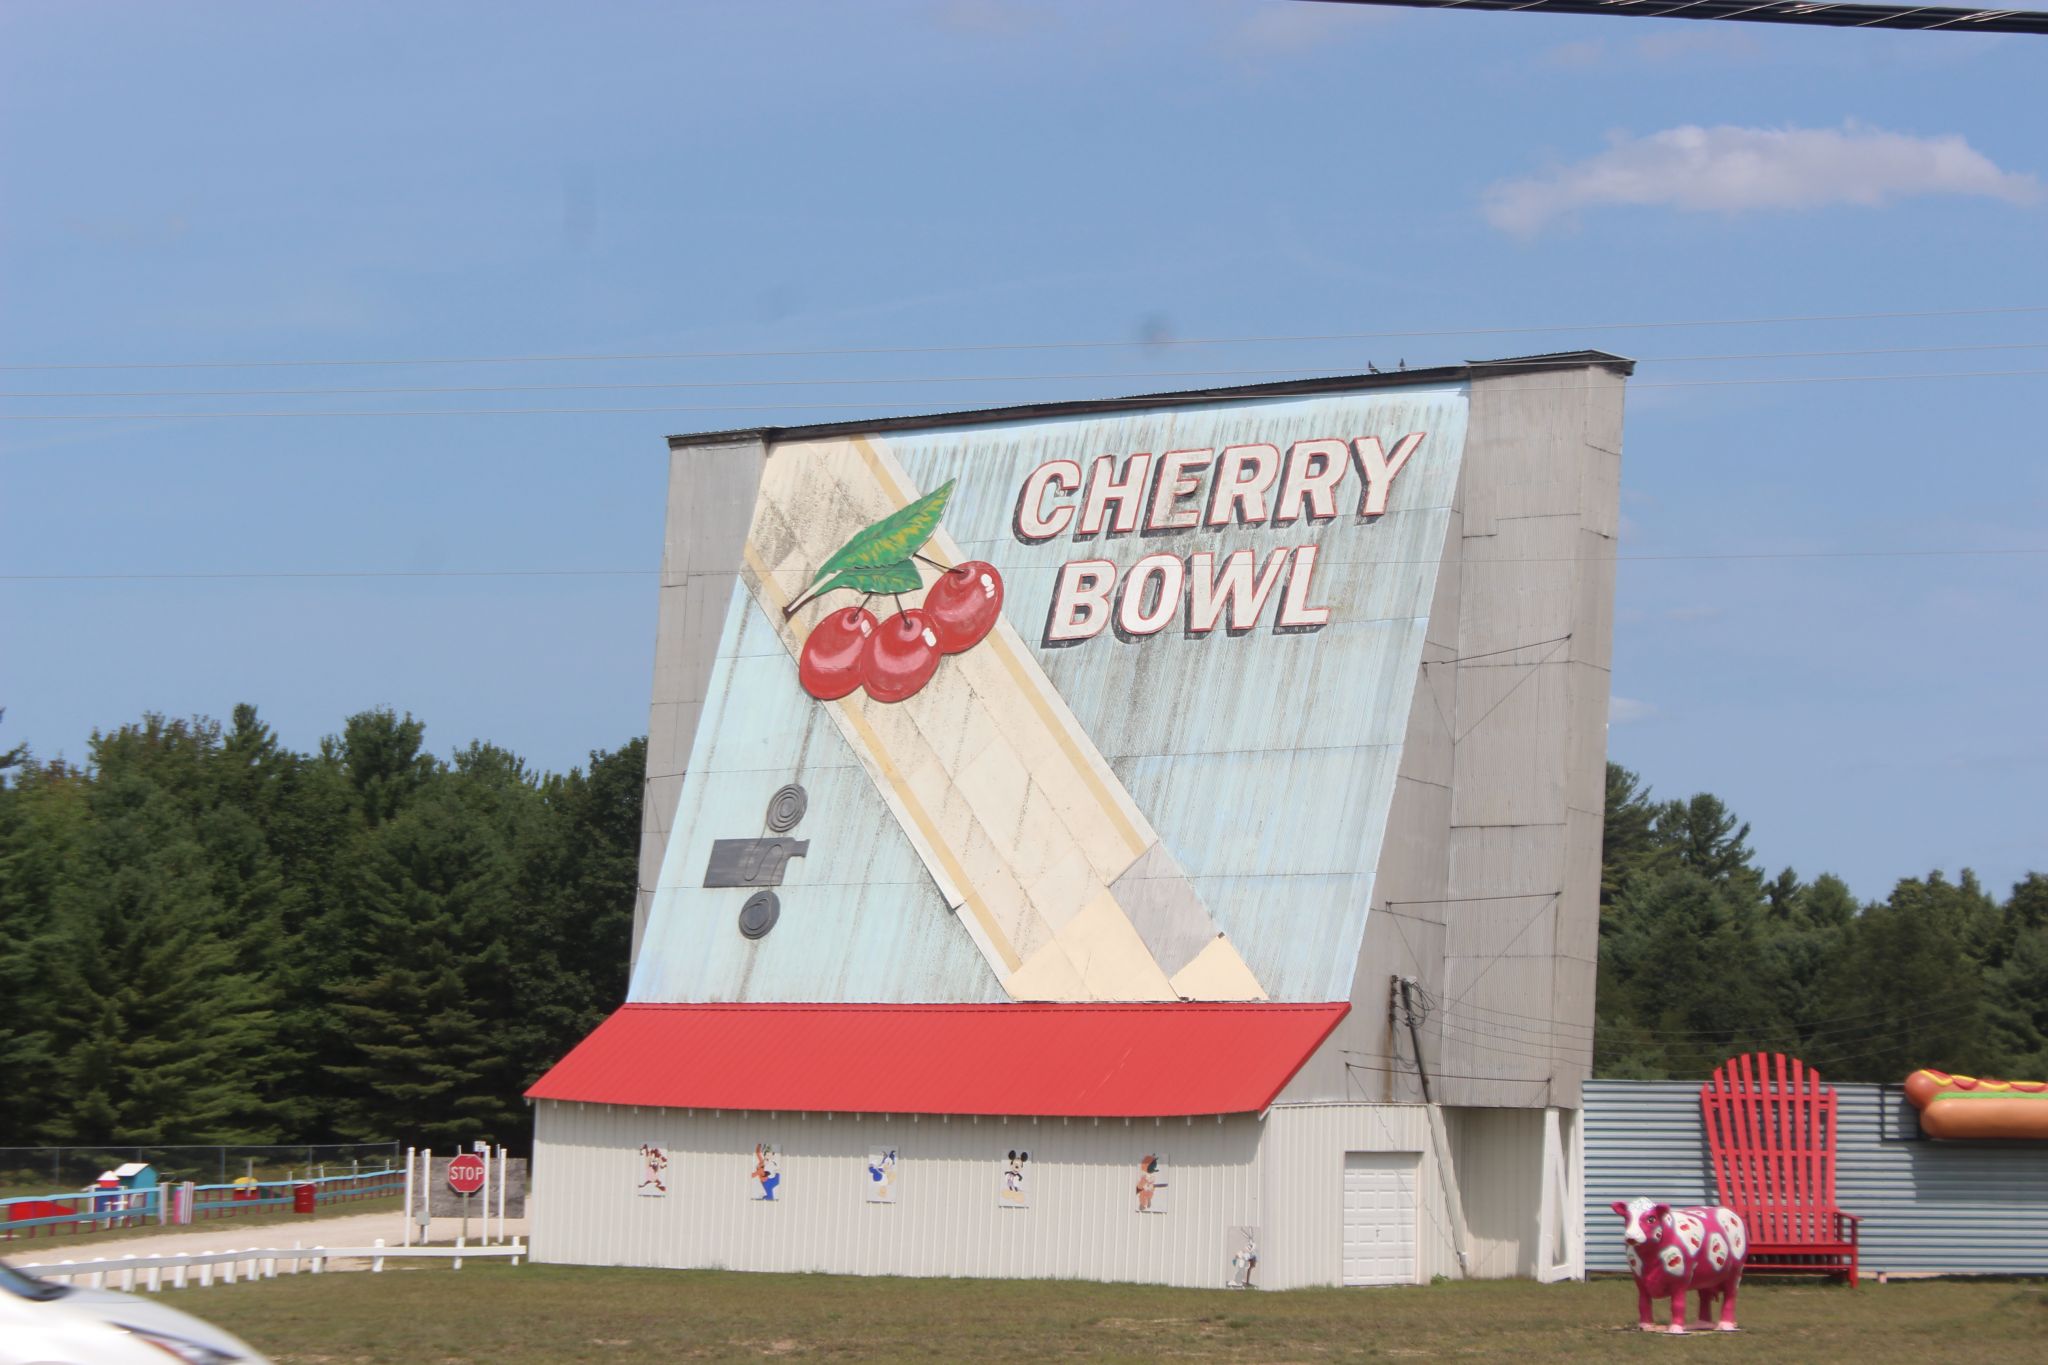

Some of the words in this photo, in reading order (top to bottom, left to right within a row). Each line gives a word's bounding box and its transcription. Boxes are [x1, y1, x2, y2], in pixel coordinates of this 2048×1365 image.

[1014, 432, 1426, 543] CHERRY
[1043, 544, 1331, 646] BOWL
[450, 1166, 484, 1180] STOP
